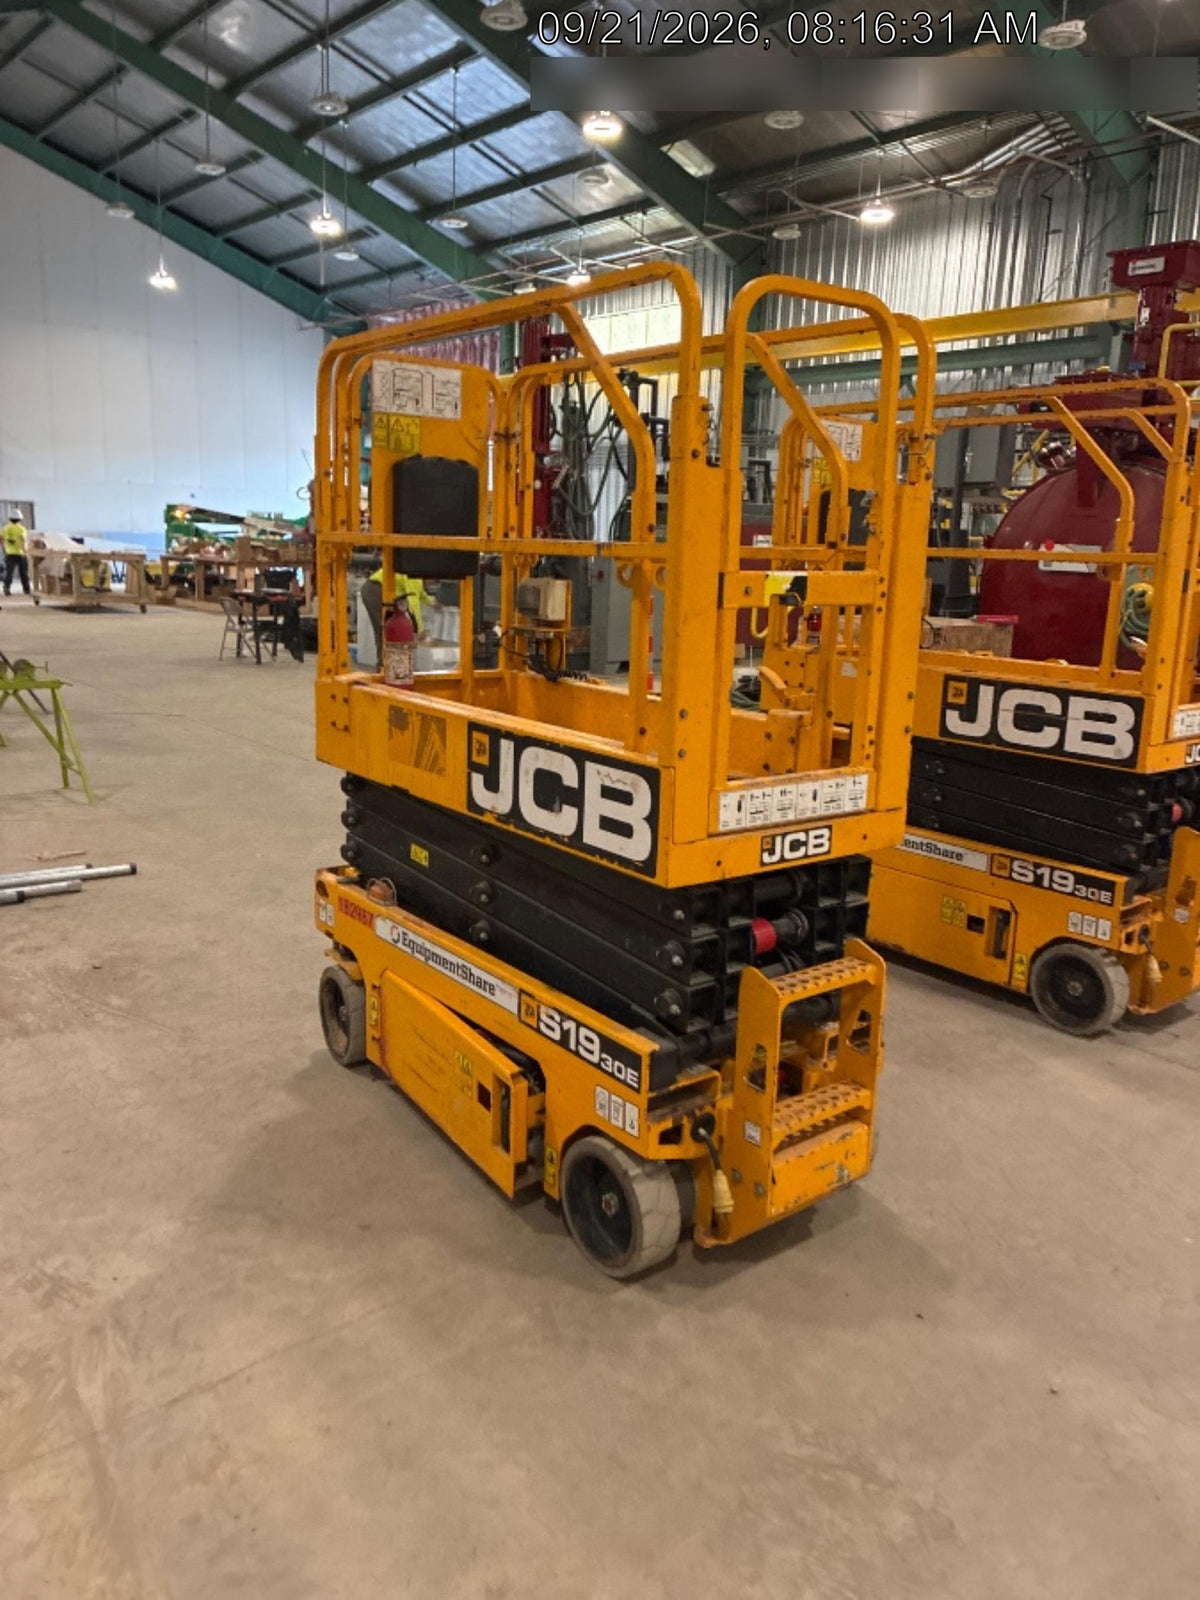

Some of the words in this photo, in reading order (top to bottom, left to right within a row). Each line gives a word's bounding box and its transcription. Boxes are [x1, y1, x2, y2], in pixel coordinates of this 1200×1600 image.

[945, 684, 1135, 760] JCB
[471, 738, 652, 861] JCB
[762, 828, 831, 865] JCB
[903, 838, 964, 862] entShare
[400, 931, 496, 996] EquipmentShare
